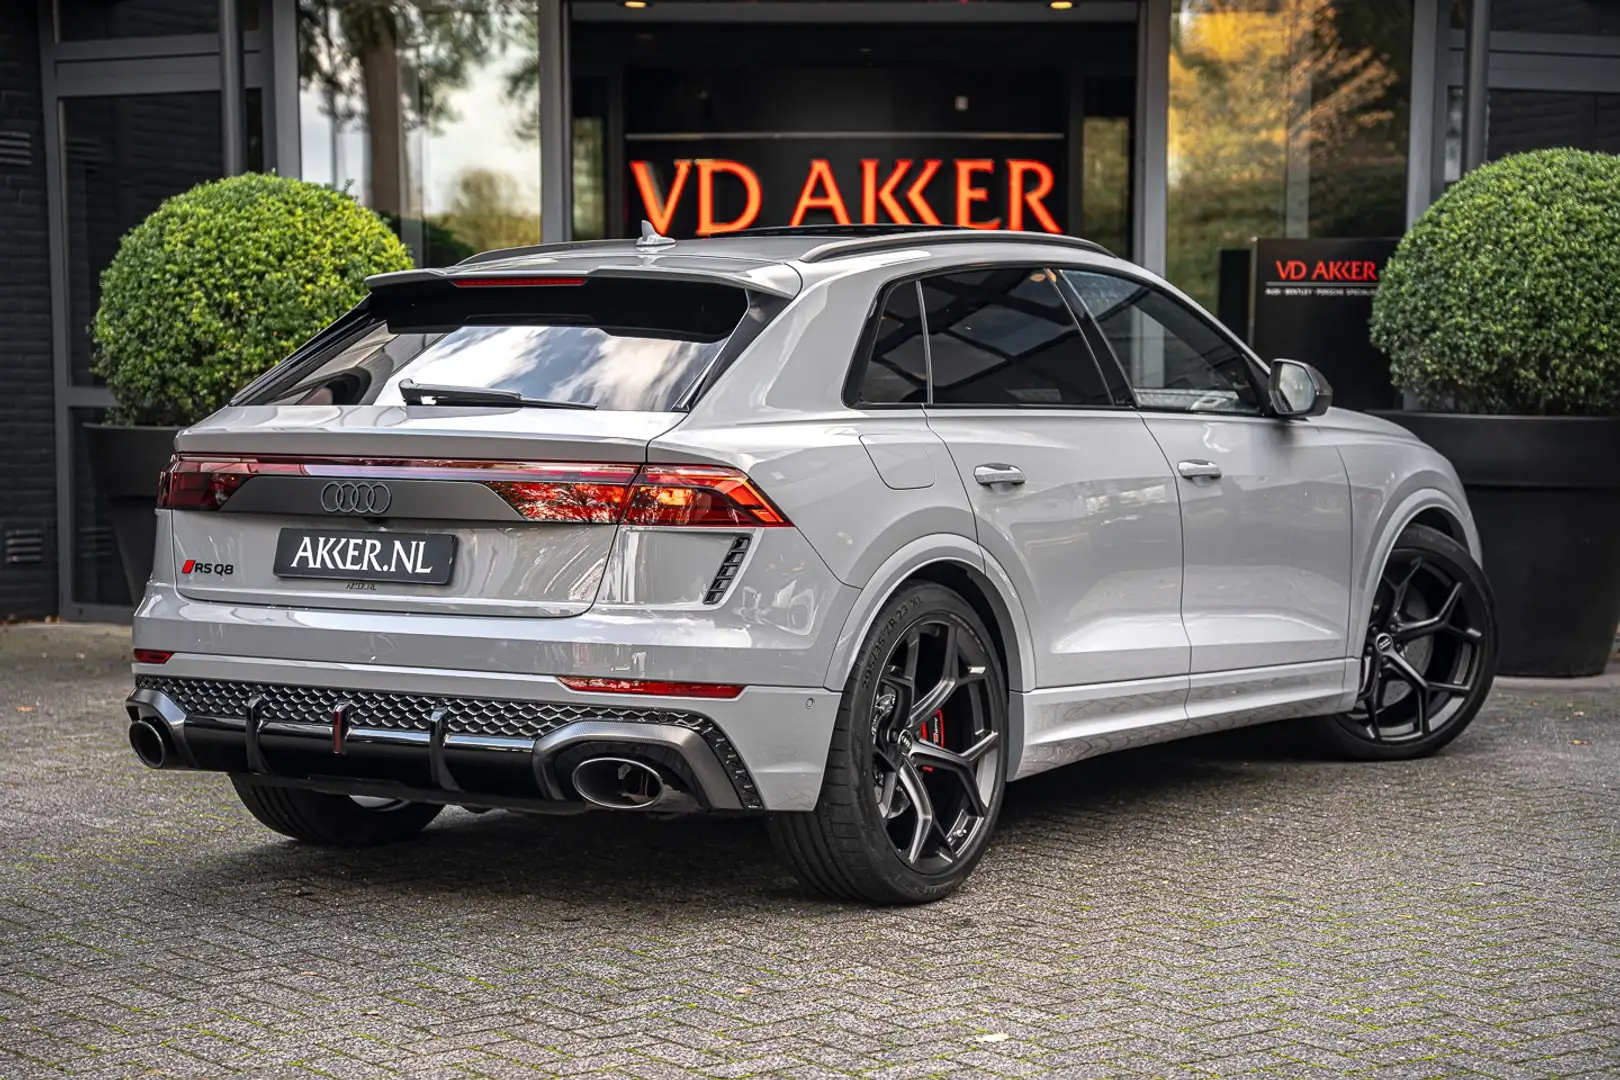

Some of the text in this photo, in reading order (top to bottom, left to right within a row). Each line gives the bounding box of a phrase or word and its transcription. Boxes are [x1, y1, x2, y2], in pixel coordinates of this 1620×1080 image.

[629, 158, 1064, 236] VD AKKER
[1275, 260, 1378, 280] VD AKKER
[290, 536, 433, 574] AKKER.NL
[194, 562, 234, 576] RS Q8
[896, 604, 909, 620] 23
